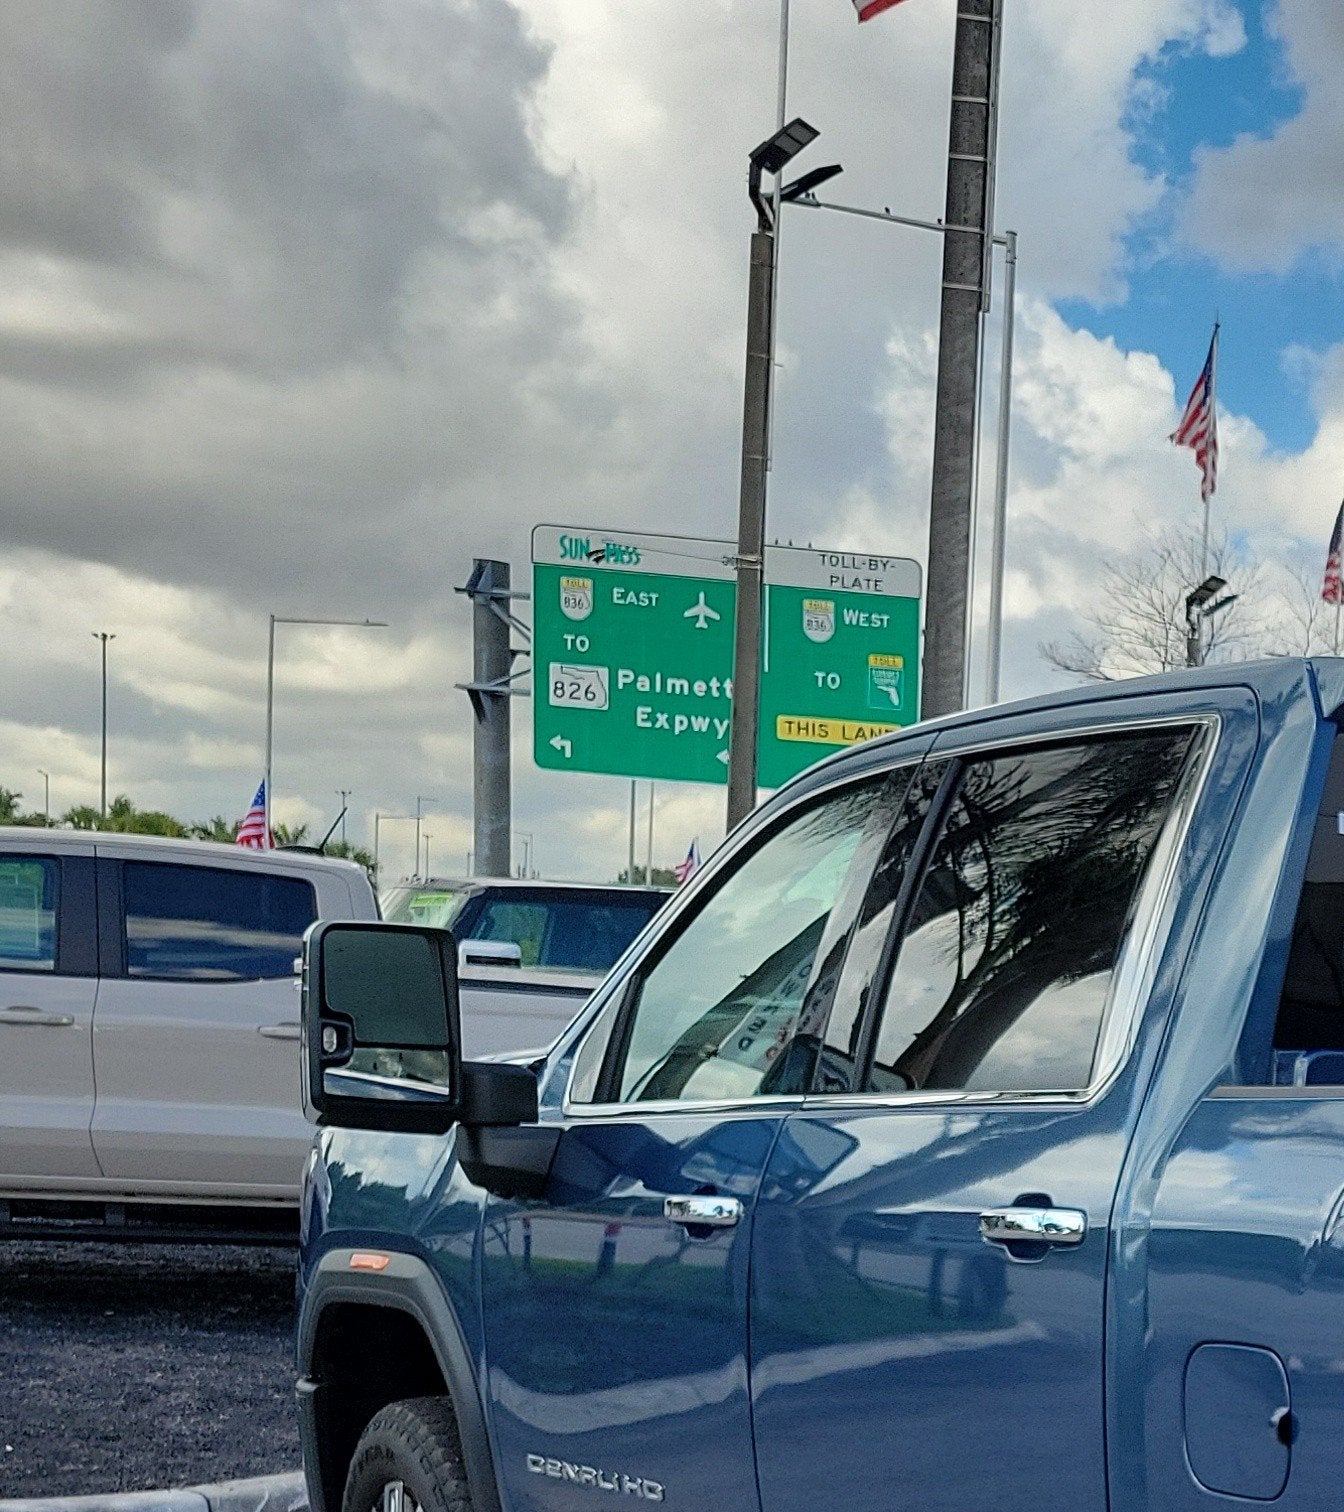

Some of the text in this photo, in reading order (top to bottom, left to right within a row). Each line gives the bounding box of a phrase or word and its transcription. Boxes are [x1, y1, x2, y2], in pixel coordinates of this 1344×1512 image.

[820, 553, 896, 572] TOLL-BY-
[830, 574, 883, 592] PLATE
[612, 587, 659, 607] EAST
[843, 608, 890, 629] WEST
[563, 633, 590, 652] TO
[617, 668, 733, 700] Palmett
[814, 670, 841, 690] TO
[553, 680, 597, 702] 826
[636, 705, 730, 740] Expwy
[784, 720, 829, 738] THIS
[526, 1453, 666, 1502] DENALI HD
